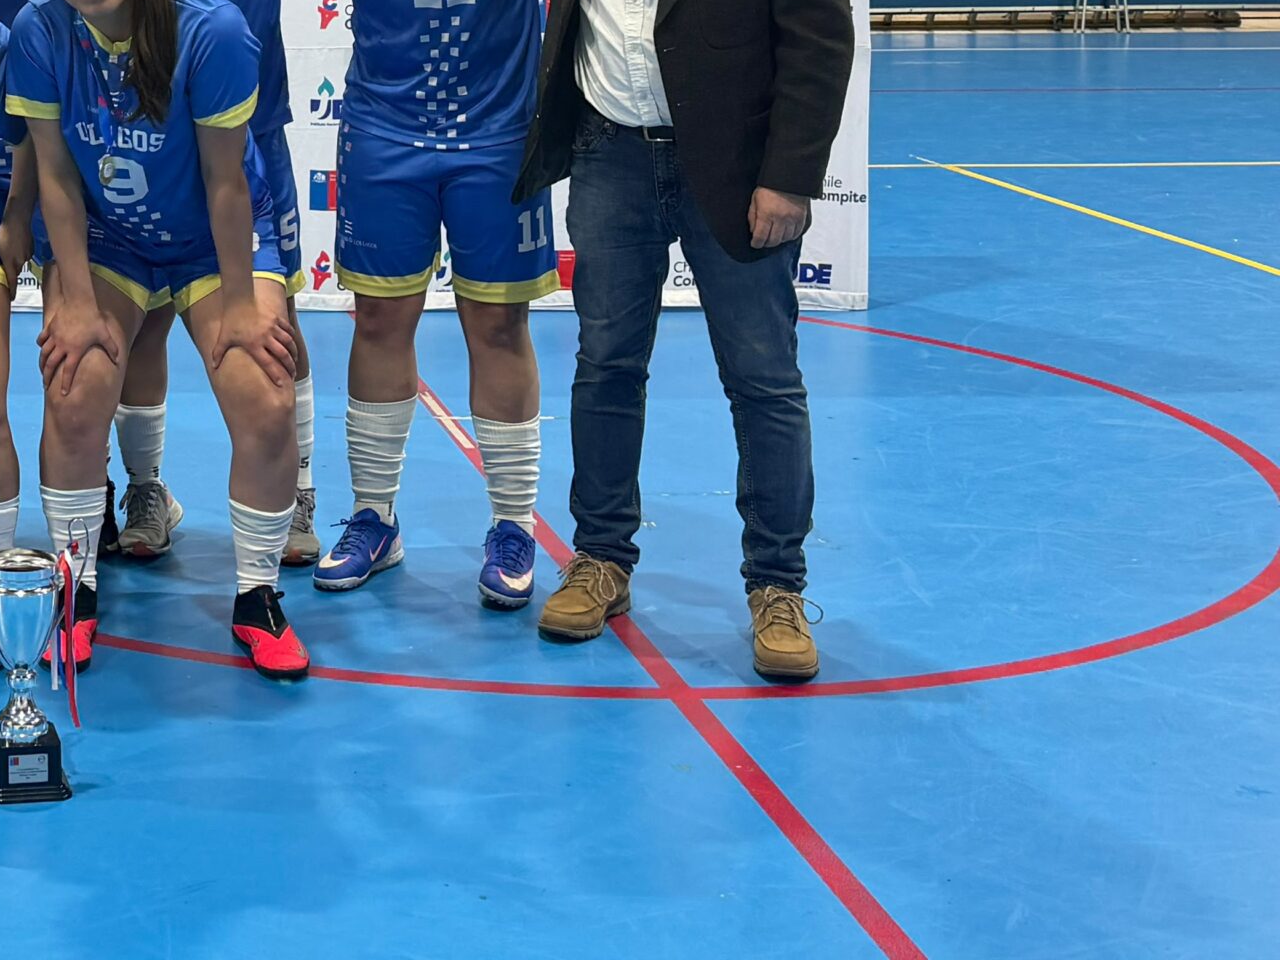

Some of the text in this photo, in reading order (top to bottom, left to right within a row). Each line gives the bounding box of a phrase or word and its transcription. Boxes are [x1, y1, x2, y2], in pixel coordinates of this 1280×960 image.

[75, 121, 166, 153] ULGOS
[98, 155, 149, 204] 9
[821, 191, 867, 205] ompite
[280, 208, 297, 251] 5
[517, 206, 548, 253] 11
